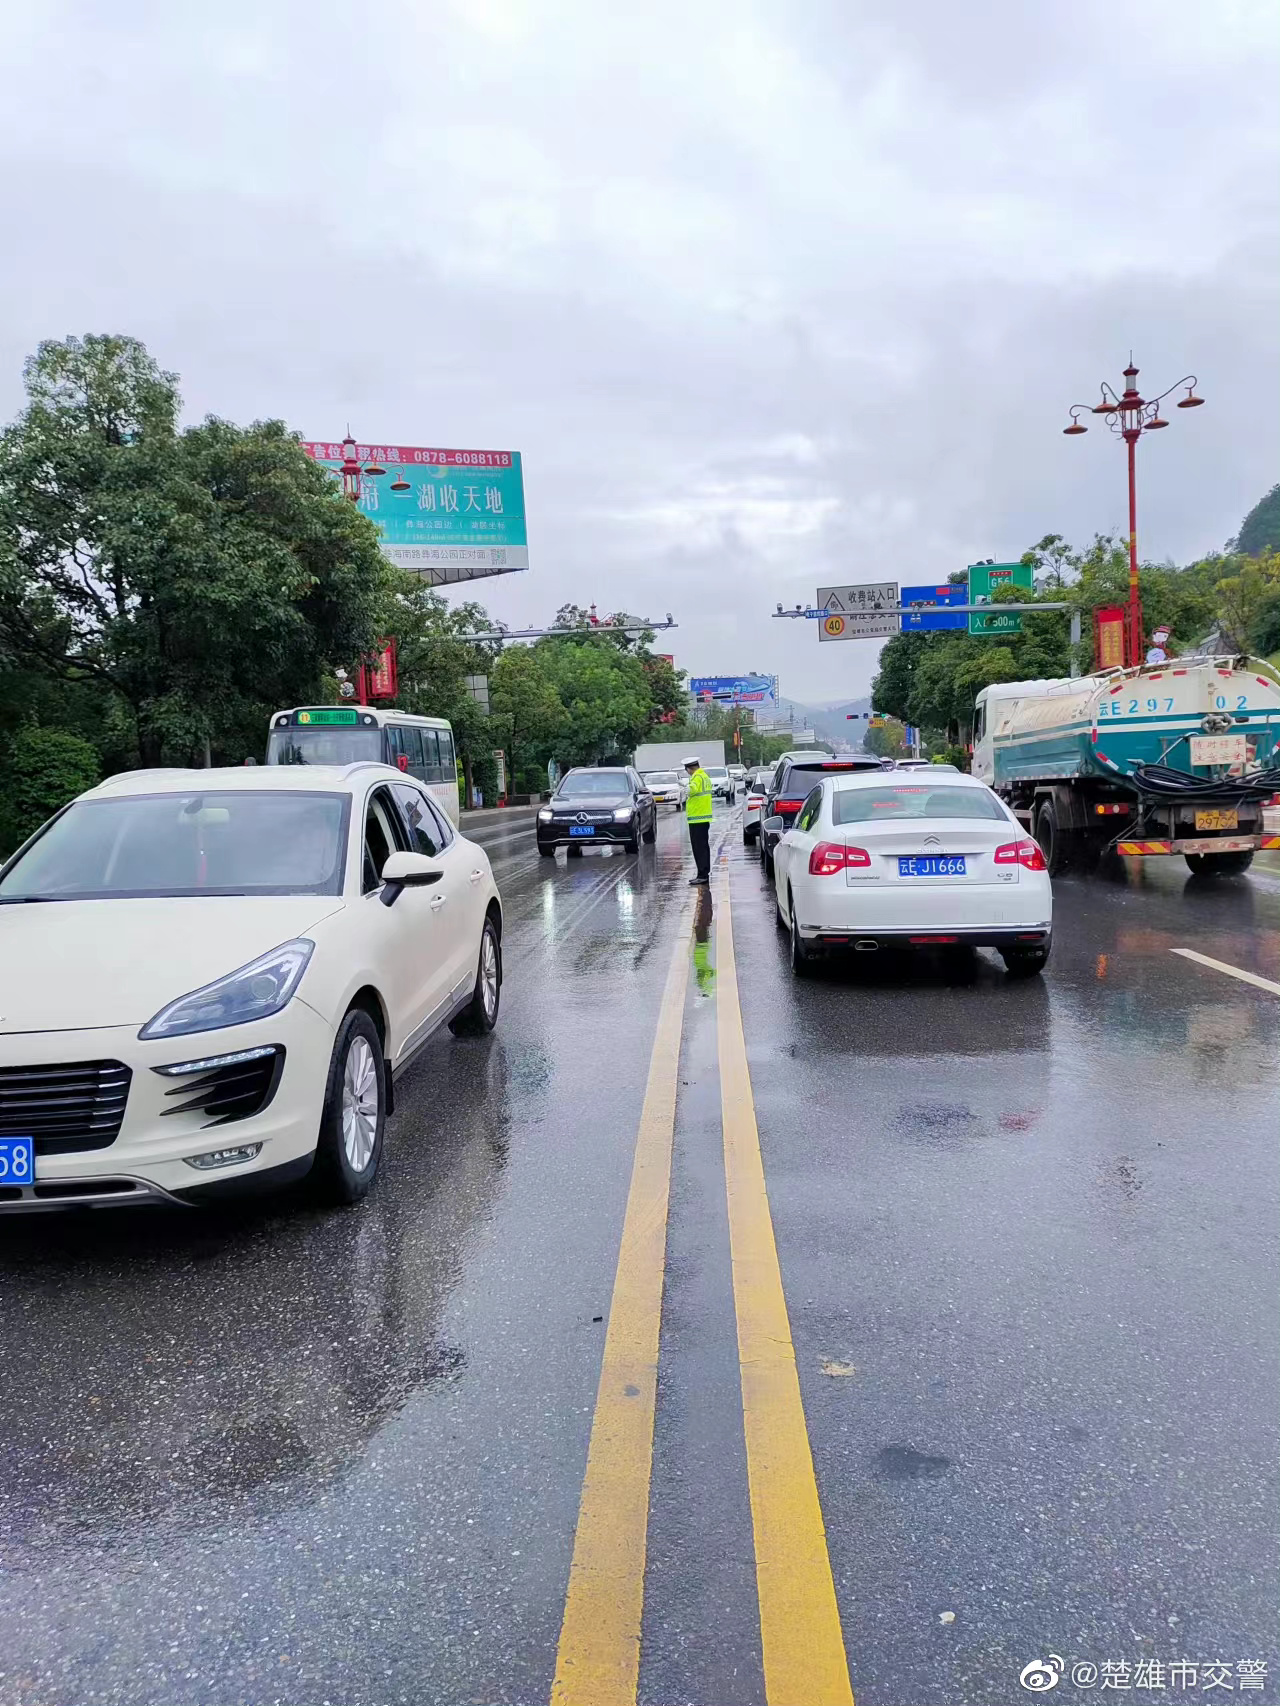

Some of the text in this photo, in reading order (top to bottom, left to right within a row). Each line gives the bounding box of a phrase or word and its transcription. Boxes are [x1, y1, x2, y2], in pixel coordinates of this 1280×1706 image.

[414, 450, 509, 465] 0878-6088118
[848, 588, 895, 604] 收费站入口
[828, 620, 841, 631] 40
